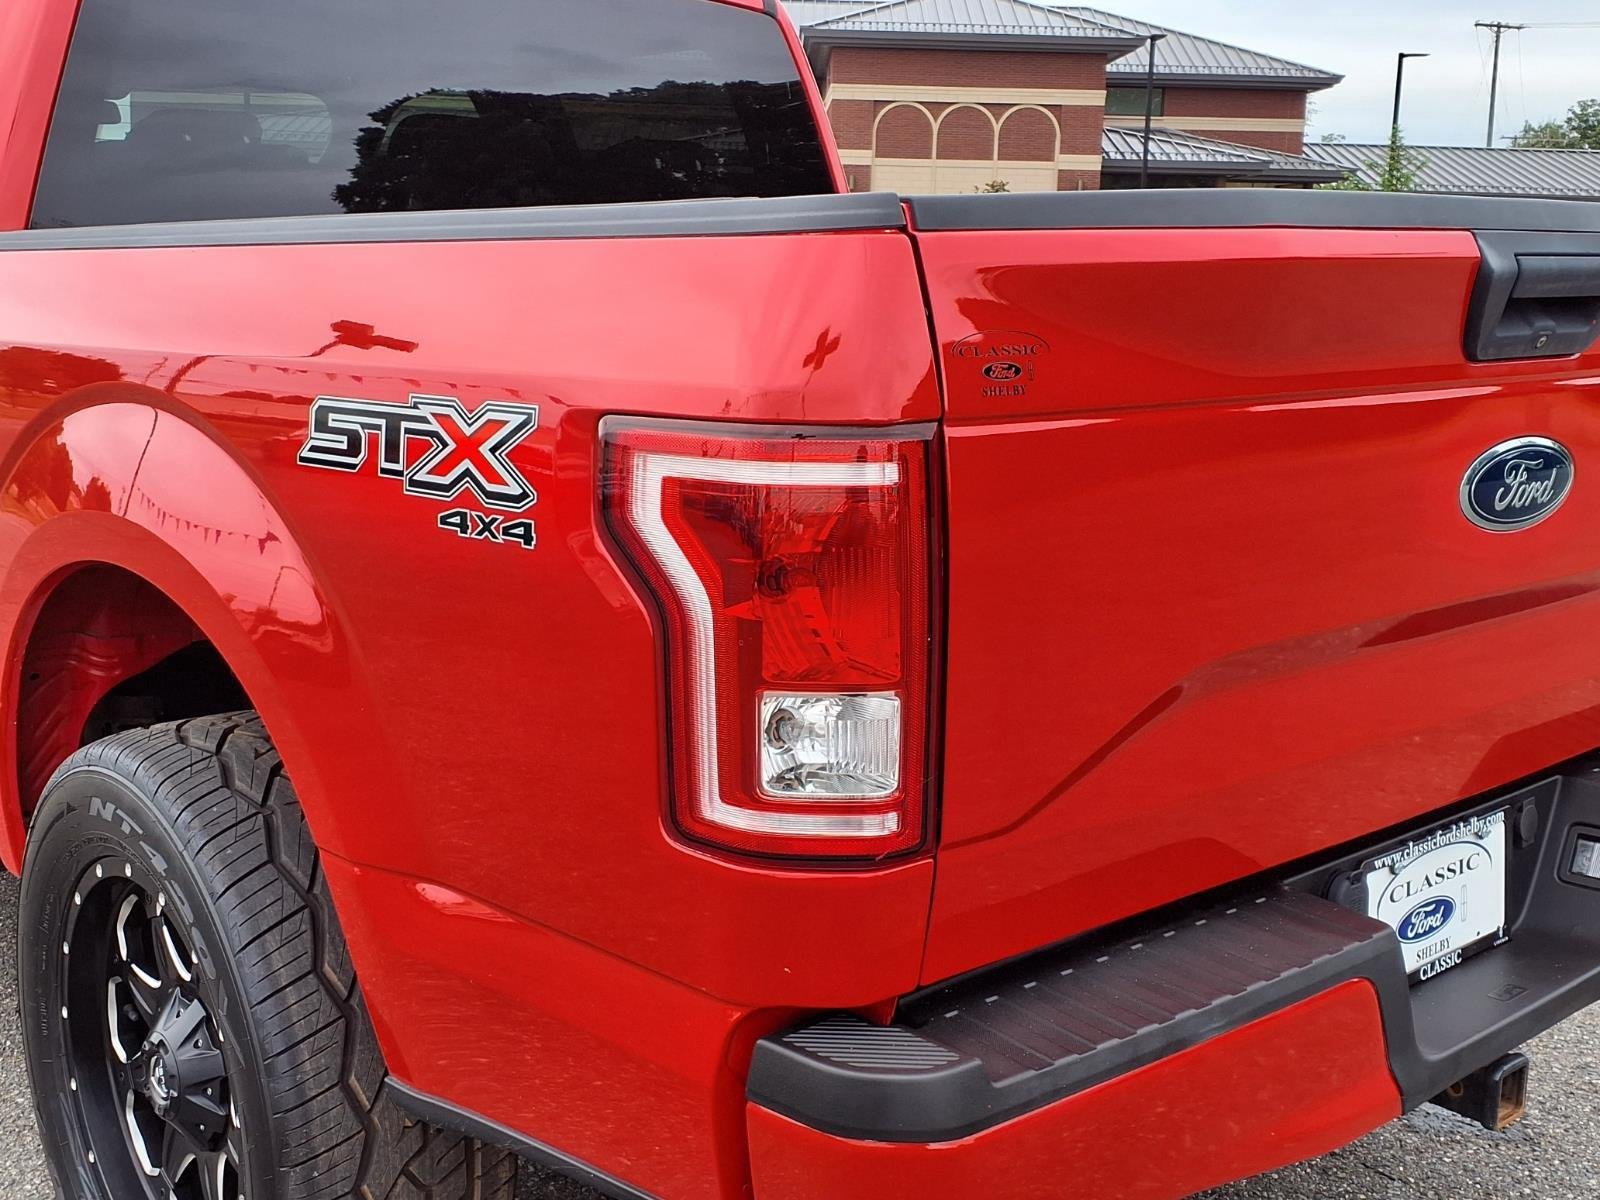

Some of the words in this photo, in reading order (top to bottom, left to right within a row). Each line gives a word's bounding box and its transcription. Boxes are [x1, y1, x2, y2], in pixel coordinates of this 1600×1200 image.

[959, 343, 1041, 358] CLASSIC
[982, 385, 1027, 398] SHELBY
[297, 393, 539, 512] STX
[1494, 458, 1558, 511] Ford
[1374, 811, 1505, 870] www.classicfordshelby.com
[1389, 852, 1481, 904] CLASSIC
[1407, 903, 1445, 938] Ford
[1416, 936, 1452, 963] SHELBY
[1420, 949, 1463, 980] CLASSIC
